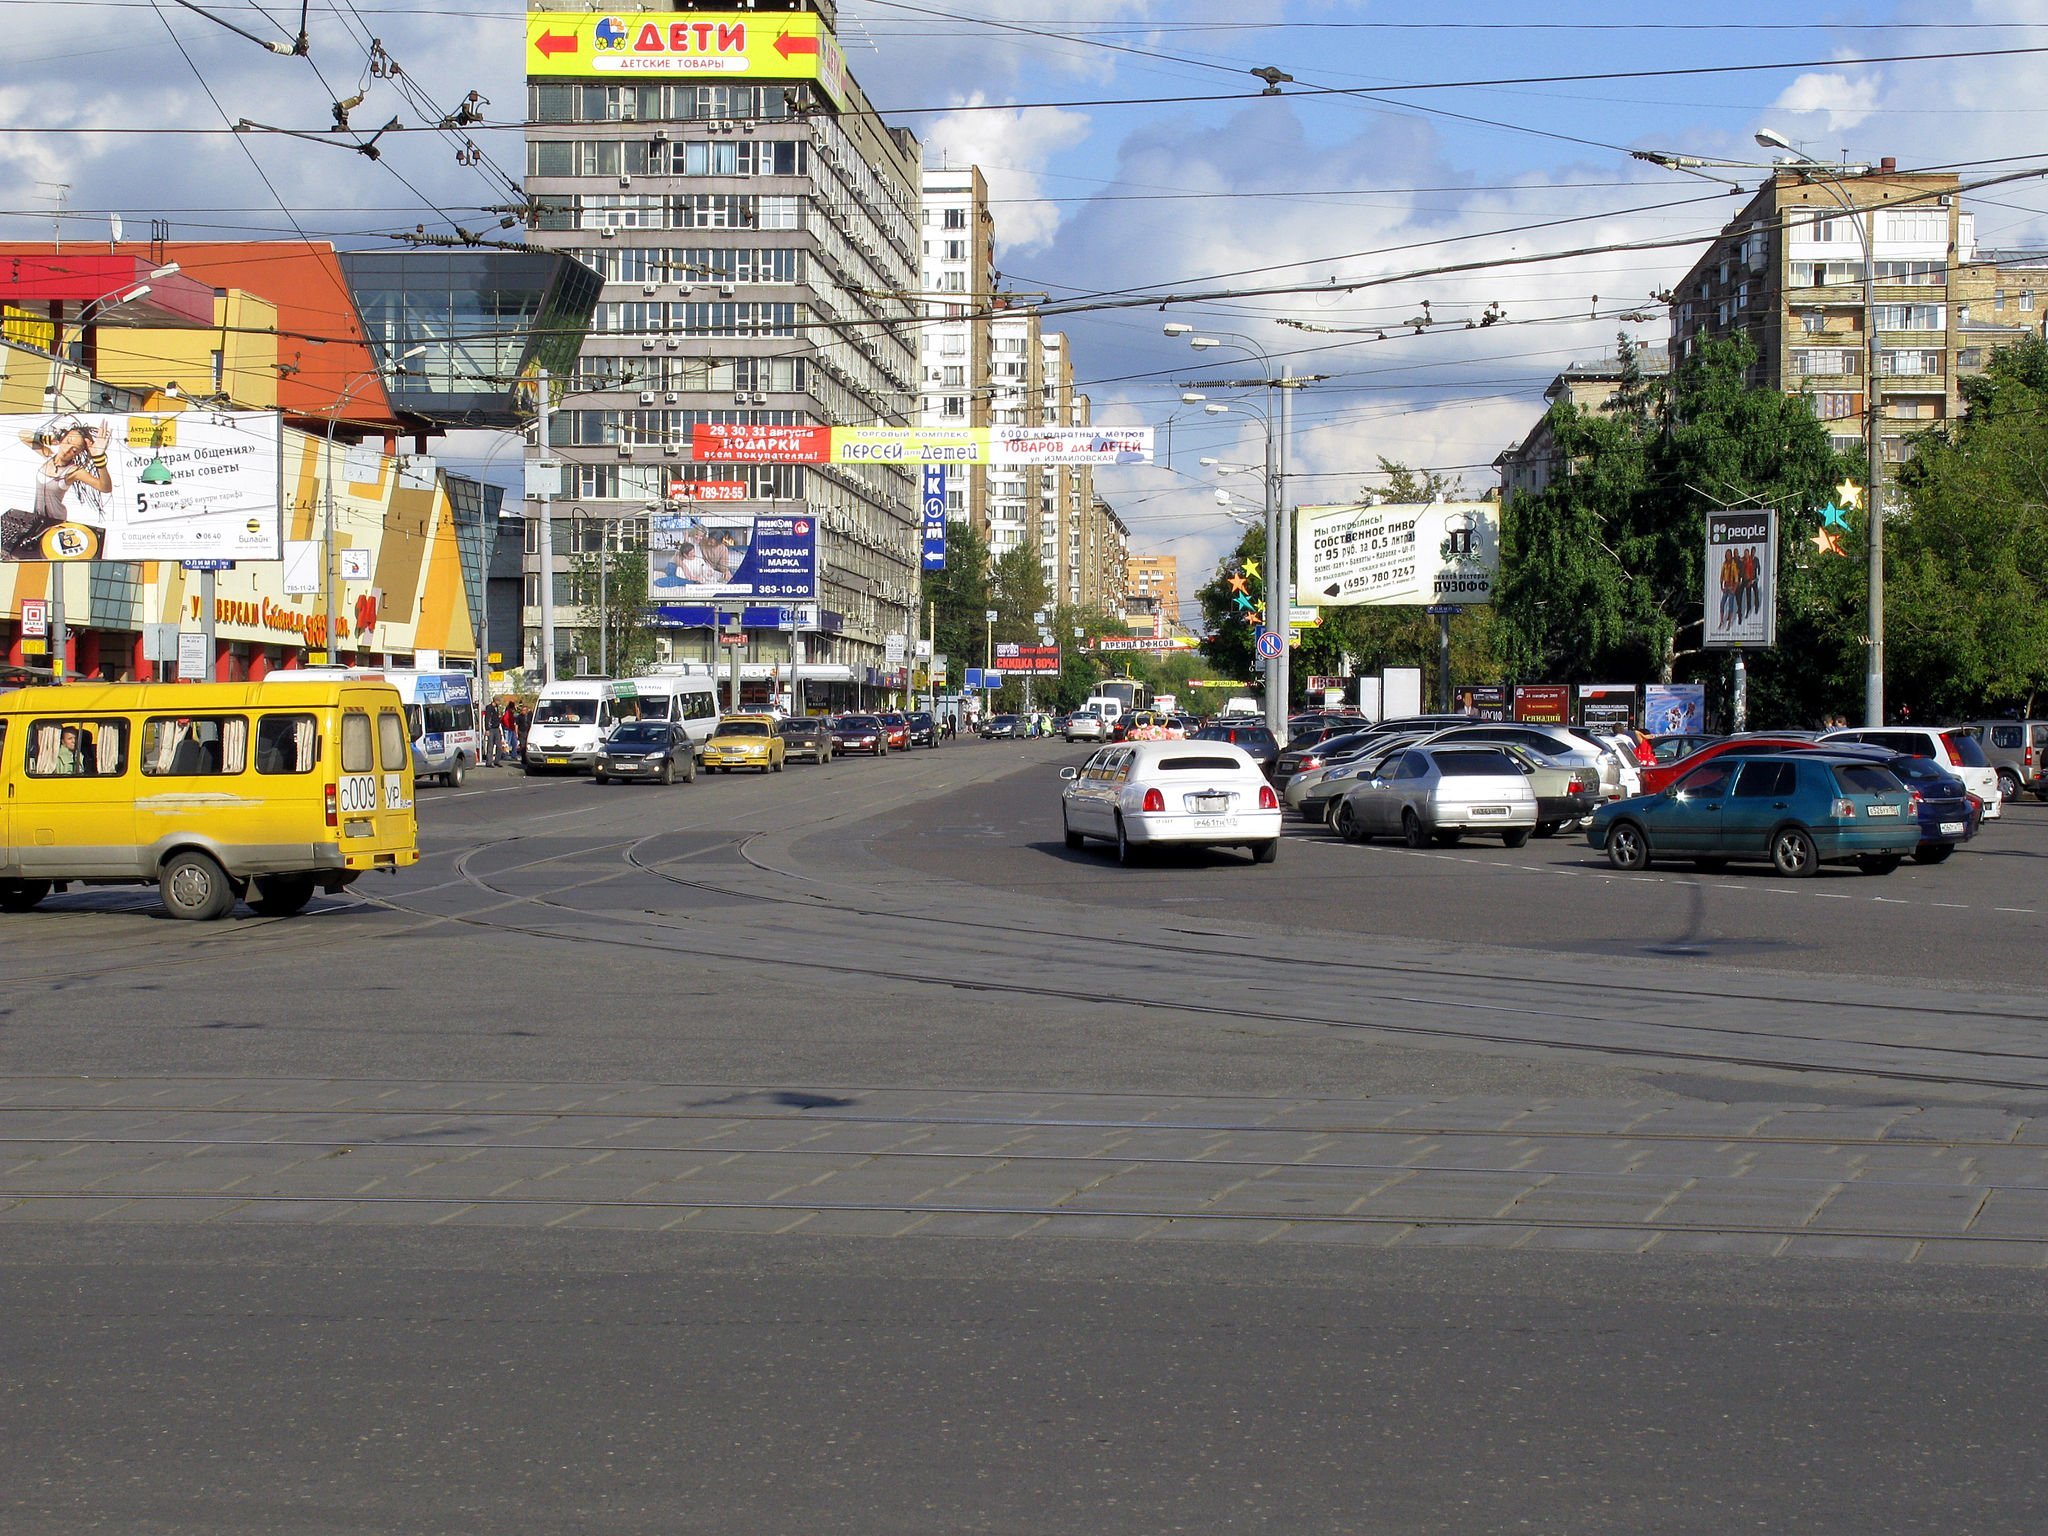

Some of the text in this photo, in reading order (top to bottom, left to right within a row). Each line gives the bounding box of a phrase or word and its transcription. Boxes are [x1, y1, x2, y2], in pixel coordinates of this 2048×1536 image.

[634, 24, 745, 52] ДЕТИ
[620, 59, 725, 69] ДЕТСКИЕ ТОВАРЫ
[709, 426, 814, 439] 29, 30, 31 августа
[1001, 430, 1029, 438] 6000
[1034, 431, 1100, 439] квадратных
[723, 438, 800, 451] ПОДАРКИ
[843, 443, 902, 459] ПЕРСЕЙ
[921, 443, 978, 459] Детей
[1005, 440, 1141, 453] ТОВАРОВ для ДЕТЕЙ
[194, 445, 256, 460] Общения»
[736, 451, 818, 461] покупателям!
[198, 464, 240, 476] советы
[195, 495, 217, 504] внутри
[220, 491, 243, 500] тарифа
[700, 487, 744, 498] 789-72-55
[137, 490, 180, 513] 5 копеек
[1314, 515, 1383, 537] Мы открылись!
[1728, 524, 1766, 540] people
[129, 532, 156, 541] опцией
[158, 532, 184, 541] «Клуб»
[1314, 520, 1415, 549] Собственное пиво
[758, 549, 809, 557] НАРОДНАЯ
[1314, 554, 1322, 563] от
[1325, 548, 1338, 560] 95
[1360, 543, 1368, 552] за
[1371, 537, 1388, 550] 0.5
[1344, 576, 1369, 590] (495)
[1372, 571, 1389, 582] 780
[1392, 565, 1415, 578] 7247
[759, 585, 809, 594] 363-10-00
[1434, 580, 1489, 593] ПУЗОФФ
[191, 596, 259, 624] УВЕРСАМ
[1105, 640, 1174, 649] АРЕНДА ОФИСОВ
[997, 658, 1033, 669] СКИДКА
[1522, 713, 1561, 722] Геннадий
